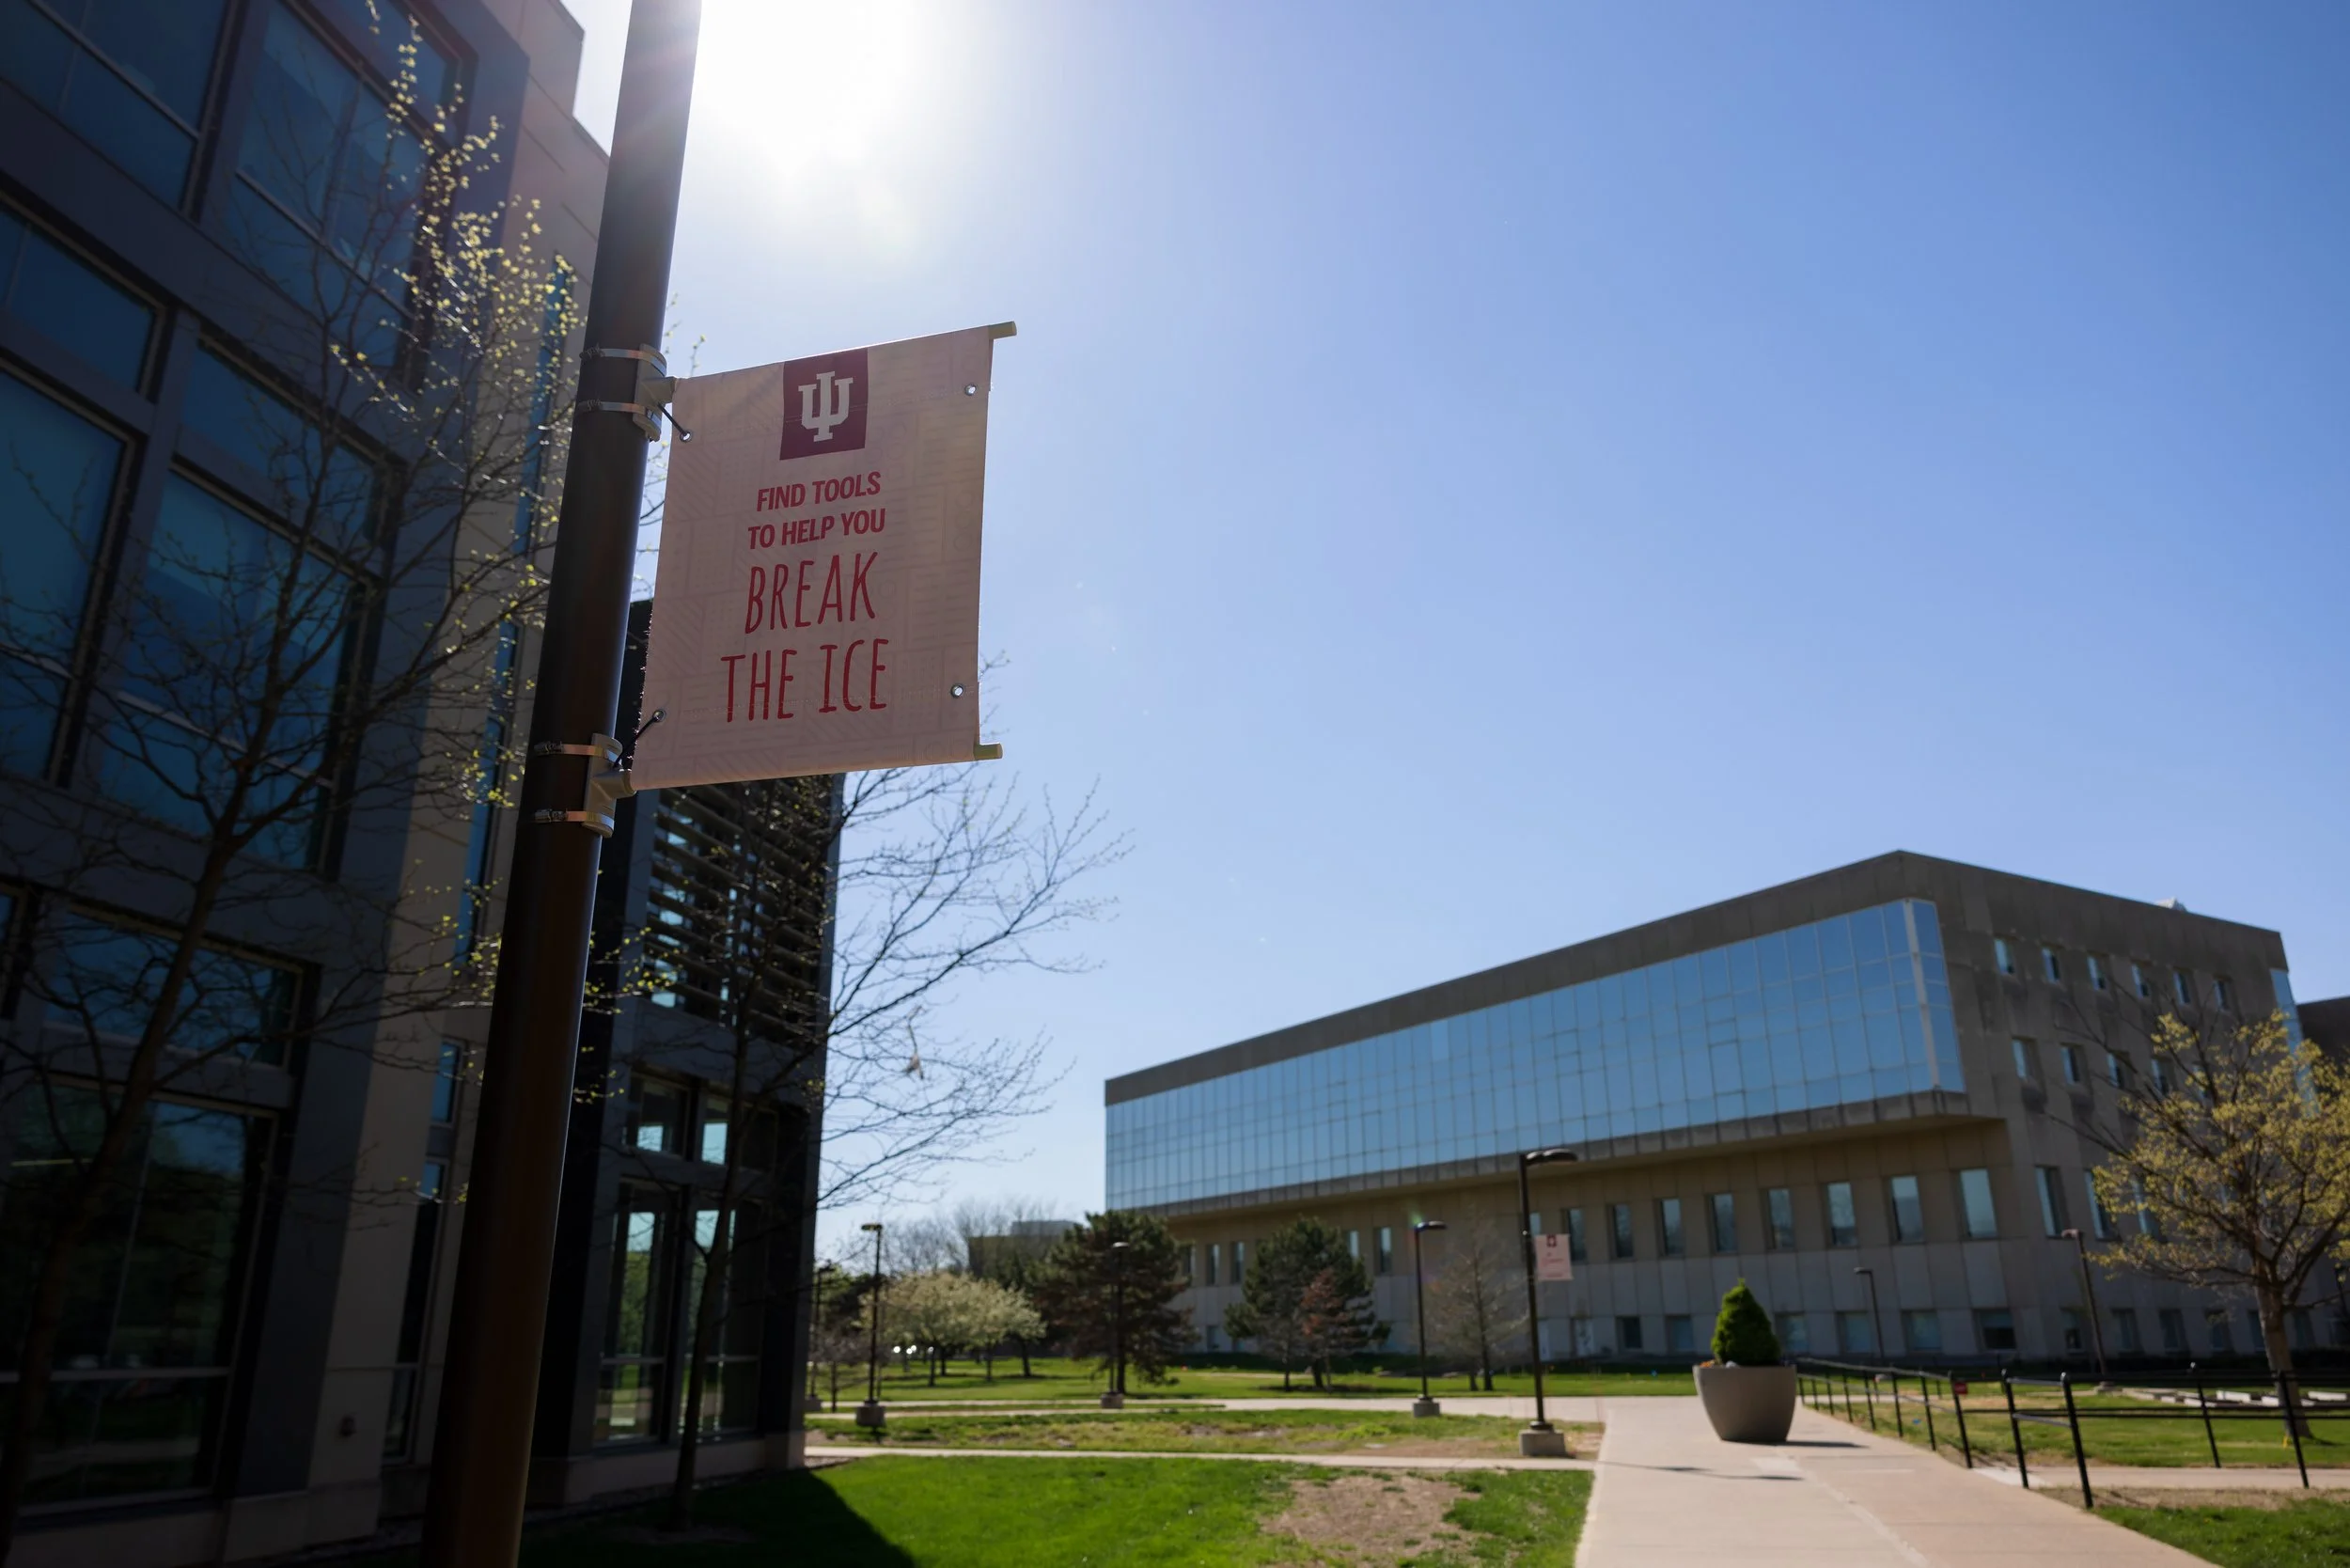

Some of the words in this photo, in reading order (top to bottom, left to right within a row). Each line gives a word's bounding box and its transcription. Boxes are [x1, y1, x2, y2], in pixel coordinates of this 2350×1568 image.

[757, 484, 806, 511] FIND
[812, 471, 882, 503] TOOLS
[748, 524, 776, 549] TO
[782, 515, 835, 545] HELP
[840, 508, 886, 536] YOU
[744, 552, 878, 635] BREAK
[720, 650, 797, 723] THE
[819, 638, 889, 713] ICE
